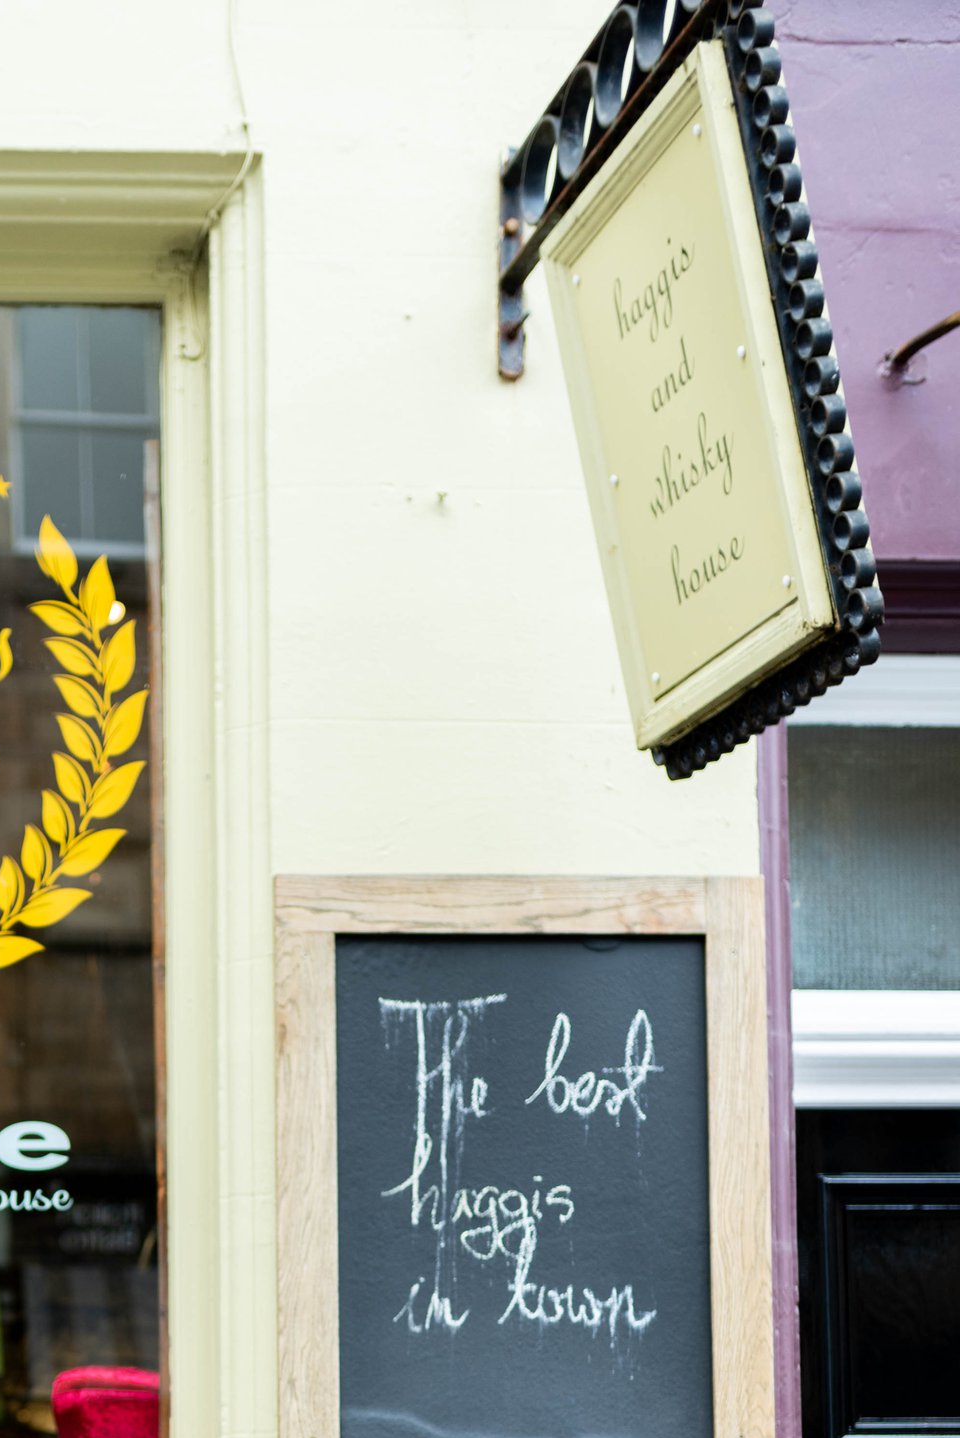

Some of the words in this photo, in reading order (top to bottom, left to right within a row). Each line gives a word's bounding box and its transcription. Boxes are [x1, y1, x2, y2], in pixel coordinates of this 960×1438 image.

[613, 237, 695, 343] haggis
[651, 335, 695, 412] and
[650, 411, 734, 519] whisky
[671, 536, 745, 606] house
[378, 993, 508, 1120] The
[524, 1008, 664, 1122] best
[381, 1132, 575, 1262] haggis
[393, 1277, 470, 1333] in
[497, 1262, 659, 1334] town
